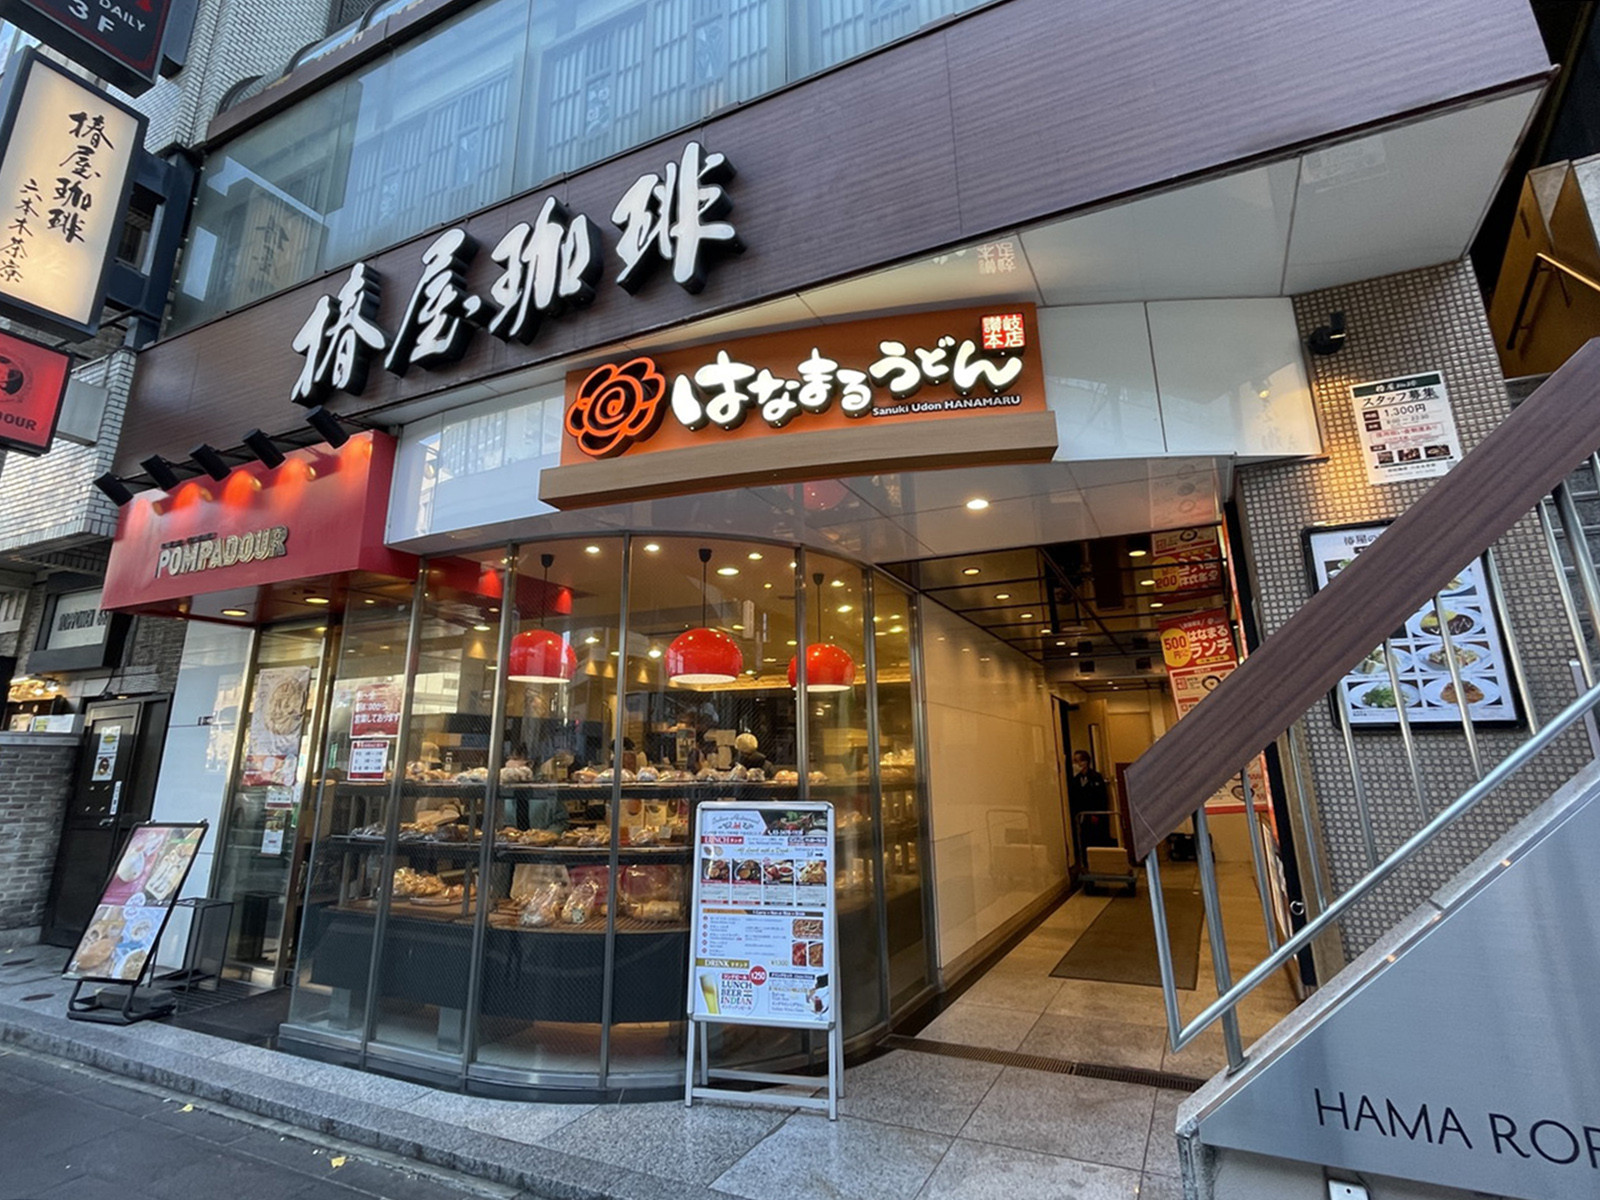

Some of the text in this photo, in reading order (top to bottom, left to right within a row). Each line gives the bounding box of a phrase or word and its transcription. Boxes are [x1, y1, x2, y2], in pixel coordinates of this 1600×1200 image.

[99, 0, 146, 31] DAILY
[48, 111, 114, 243] 椿屋珈琲
[291, 141, 736, 401] 椿屋珈琲
[672, 335, 1023, 430] はなまるうどん
[873, 395, 1021, 416] Sanuki Udon HANAMARU
[155, 525, 289, 578] POMPADOUR
[1163, 635, 1187, 651] 500
[1187, 625, 1229, 641] はなまる
[1191, 638, 1232, 659] ランチ
[721, 981, 753, 989] LUNCH
[720, 997, 753, 1005] INDIAN
[1314, 1088, 1473, 1150] HAMA
